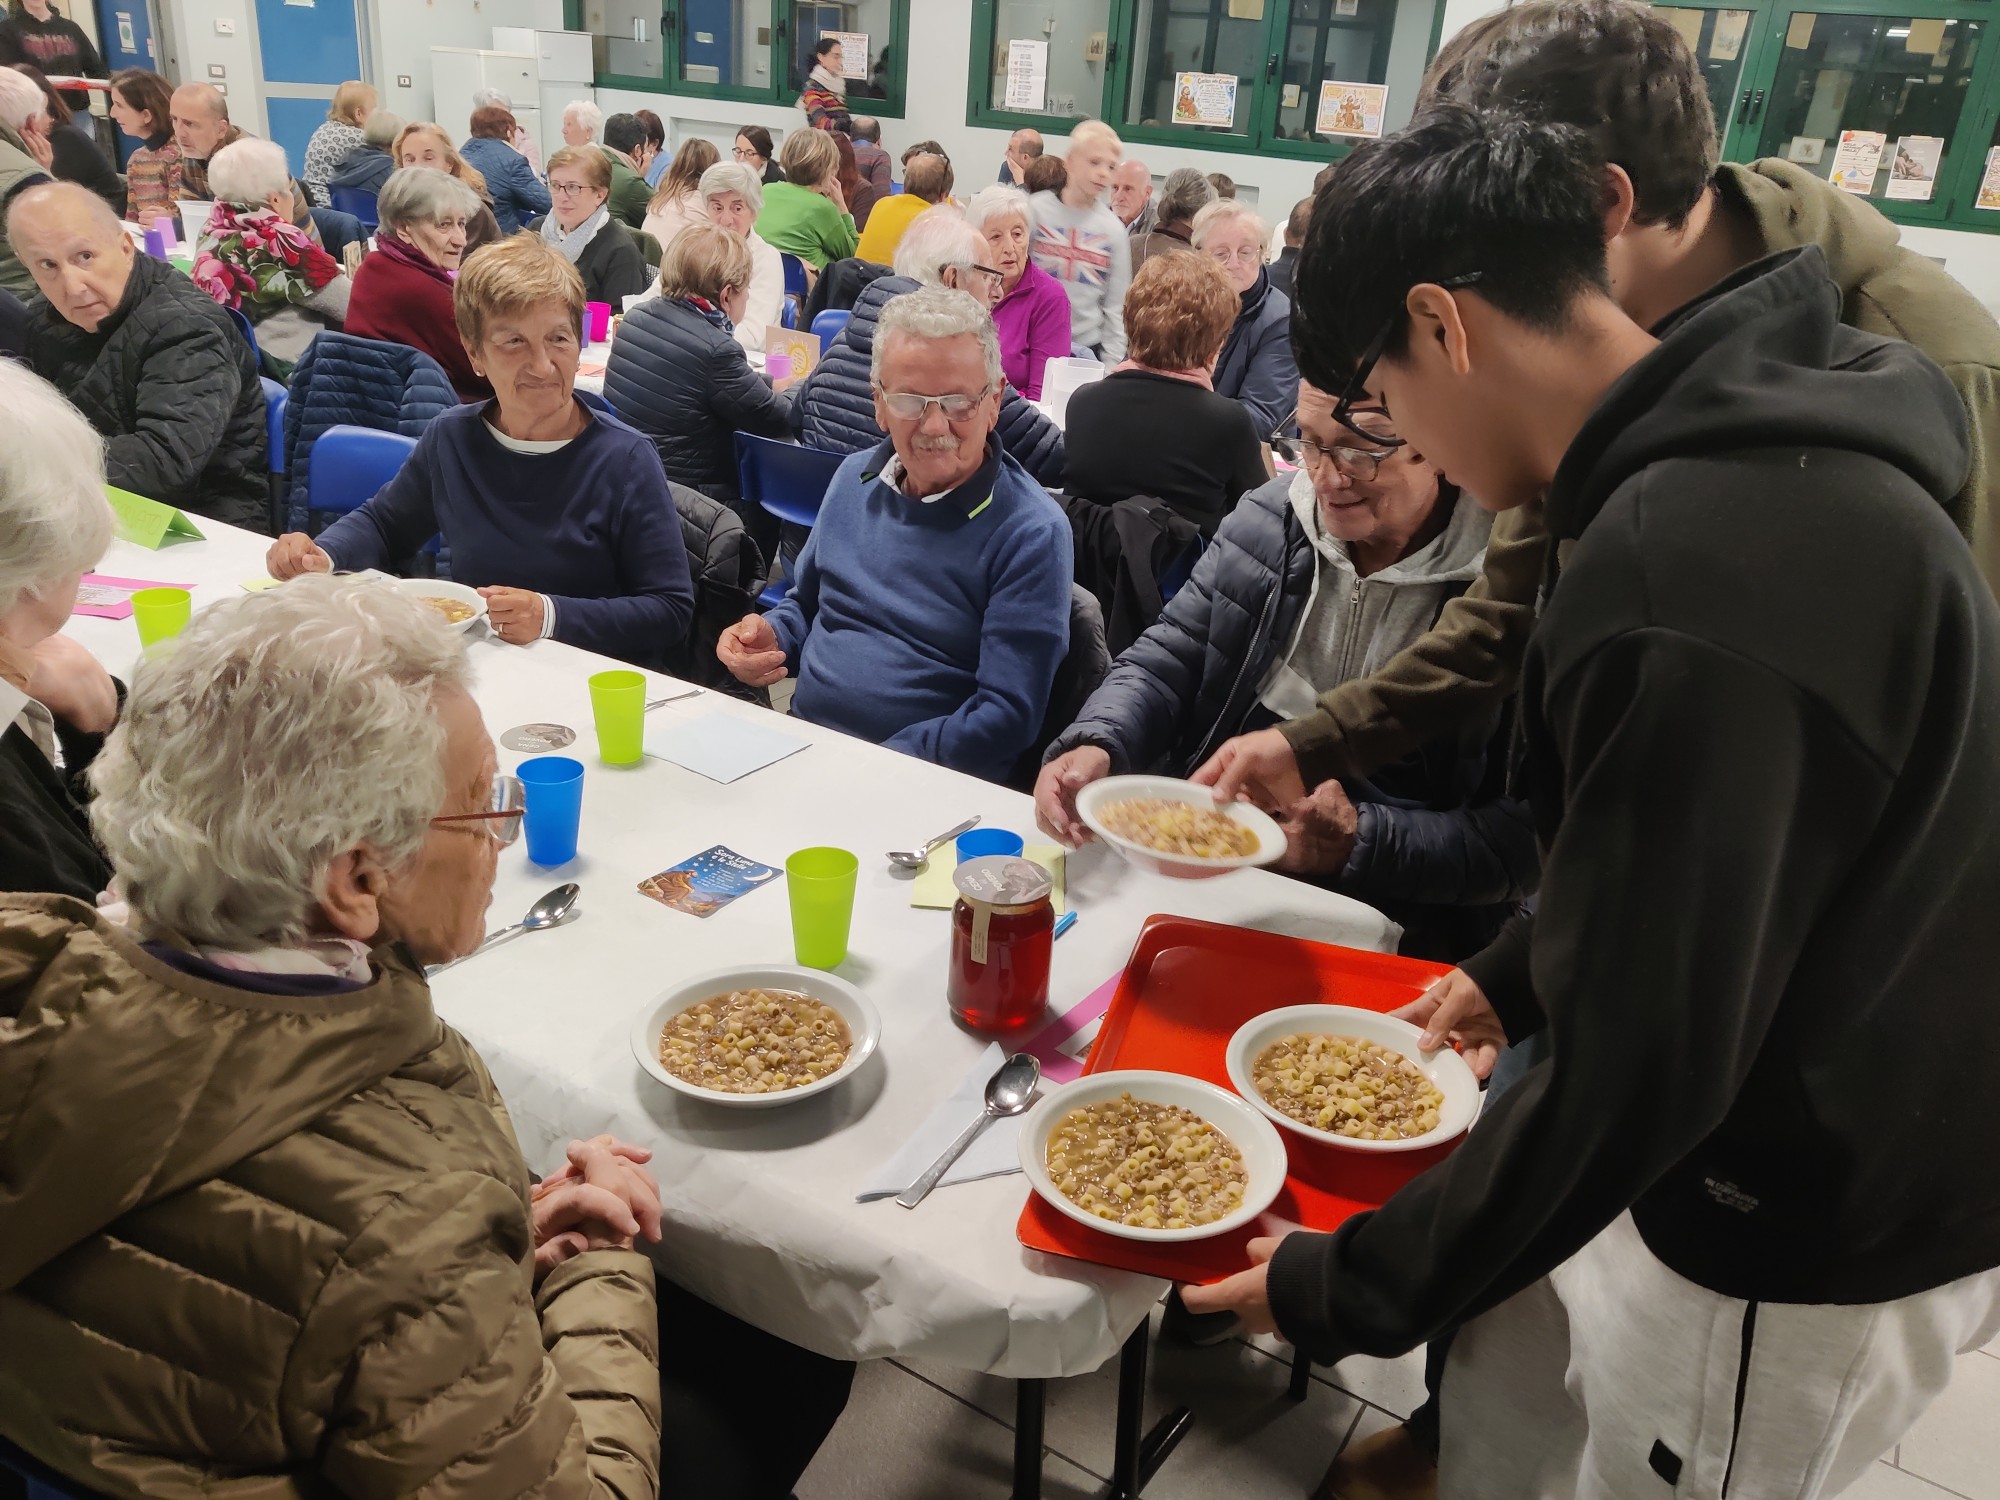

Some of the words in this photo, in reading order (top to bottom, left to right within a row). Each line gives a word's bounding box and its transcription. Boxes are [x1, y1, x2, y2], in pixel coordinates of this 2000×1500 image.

[714, 849, 735, 860] Sora
[735, 857, 755, 867] Luna
[964, 875, 982, 891] CENA
[981, 868, 1006, 891] POVERO
